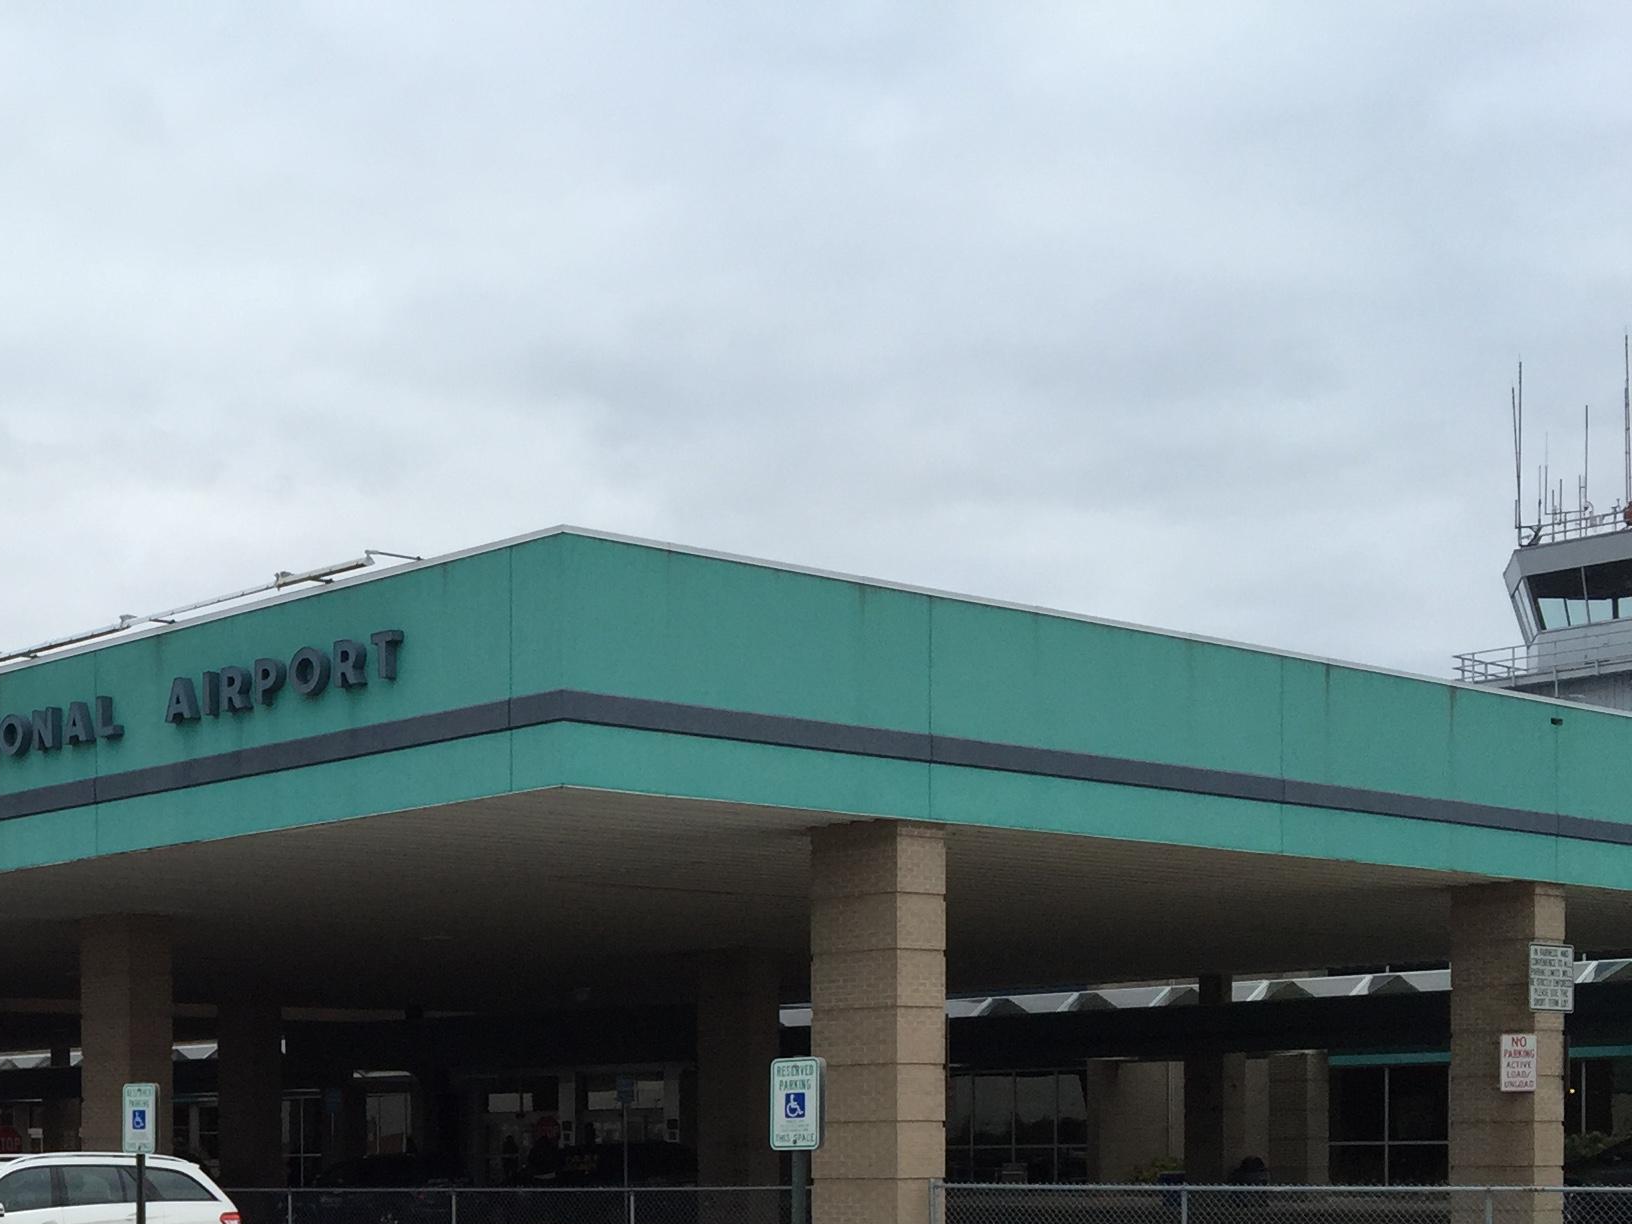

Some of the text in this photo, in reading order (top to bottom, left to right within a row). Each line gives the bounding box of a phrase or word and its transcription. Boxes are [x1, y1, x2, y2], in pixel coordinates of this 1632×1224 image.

[166, 629, 405, 724] AIRPORT
[1512, 1036, 1527, 1048] NO
[1503, 1049, 1535, 1058] PARKING
[776, 1064, 814, 1077] RESERVED
[1506, 1061, 1531, 1069] ACTIVE
[779, 1079, 811, 1091] PARKING
[792, 1132, 815, 1143] SPACE
